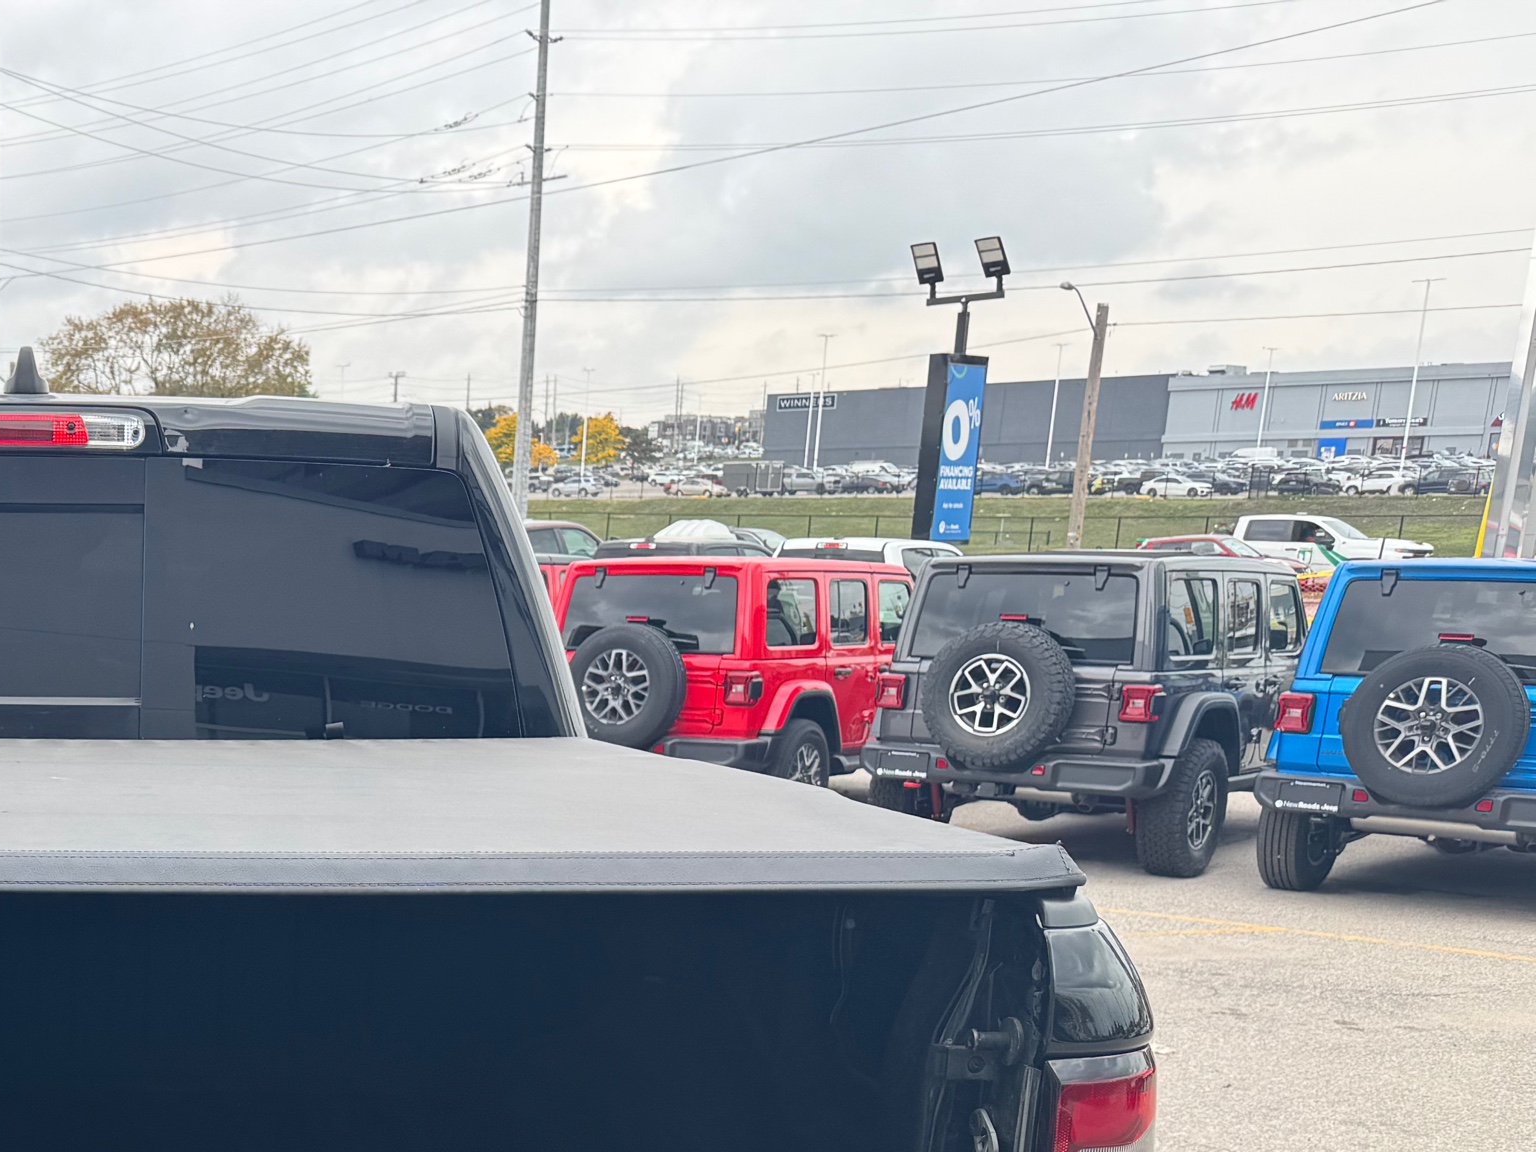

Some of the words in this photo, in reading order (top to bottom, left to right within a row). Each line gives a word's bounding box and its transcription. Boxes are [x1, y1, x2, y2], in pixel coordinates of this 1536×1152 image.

[1331, 391, 1368, 402] ARITZIA
[942, 397, 981, 461] 0%
[939, 465, 974, 477] FINANCING
[939, 478, 972, 490] AVAILABLE
[1283, 800, 1321, 811] NewRoads
[1321, 802, 1339, 813] Jeep
